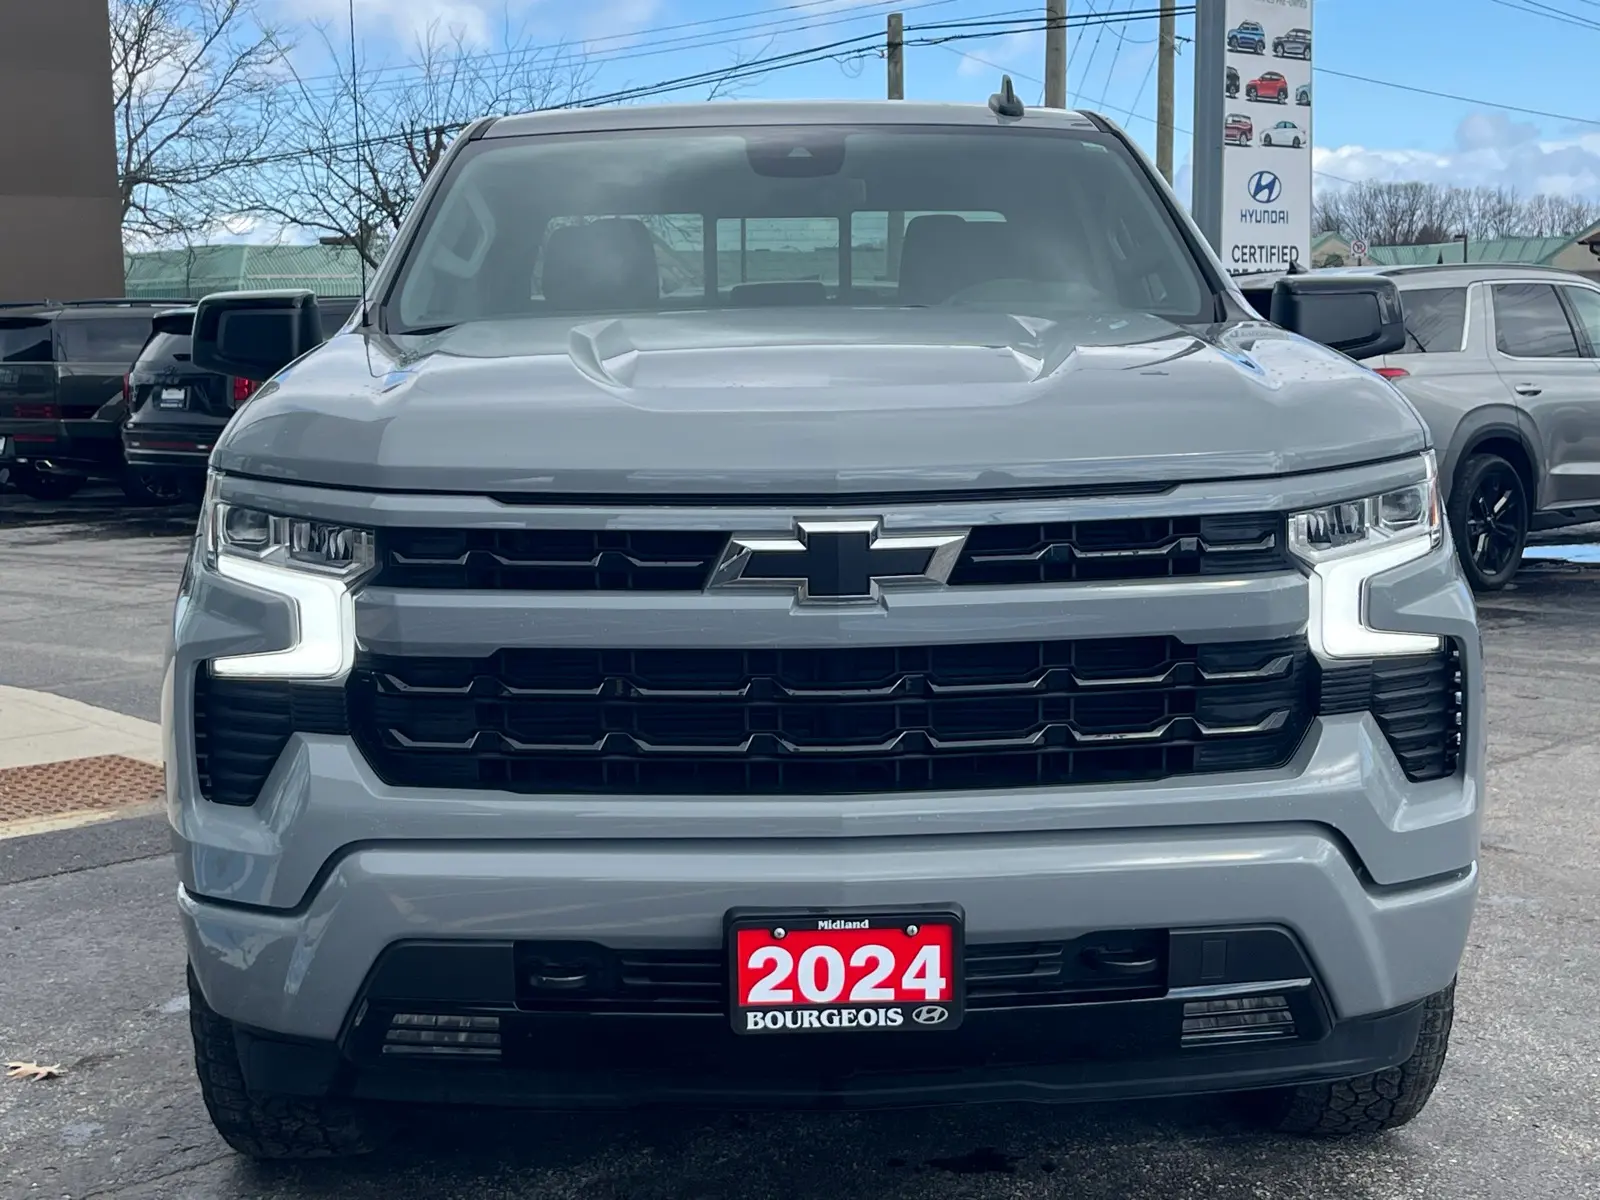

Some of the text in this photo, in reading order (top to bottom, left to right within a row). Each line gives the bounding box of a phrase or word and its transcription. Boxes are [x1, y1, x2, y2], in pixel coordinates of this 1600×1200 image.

[1240, 209, 1289, 224] HYUNDAI
[1231, 244, 1299, 264] CERTIFIED
[817, 918, 870, 930] Midland
[747, 944, 947, 1003] 2024
[746, 1008, 904, 1030] BOURGEOIS
